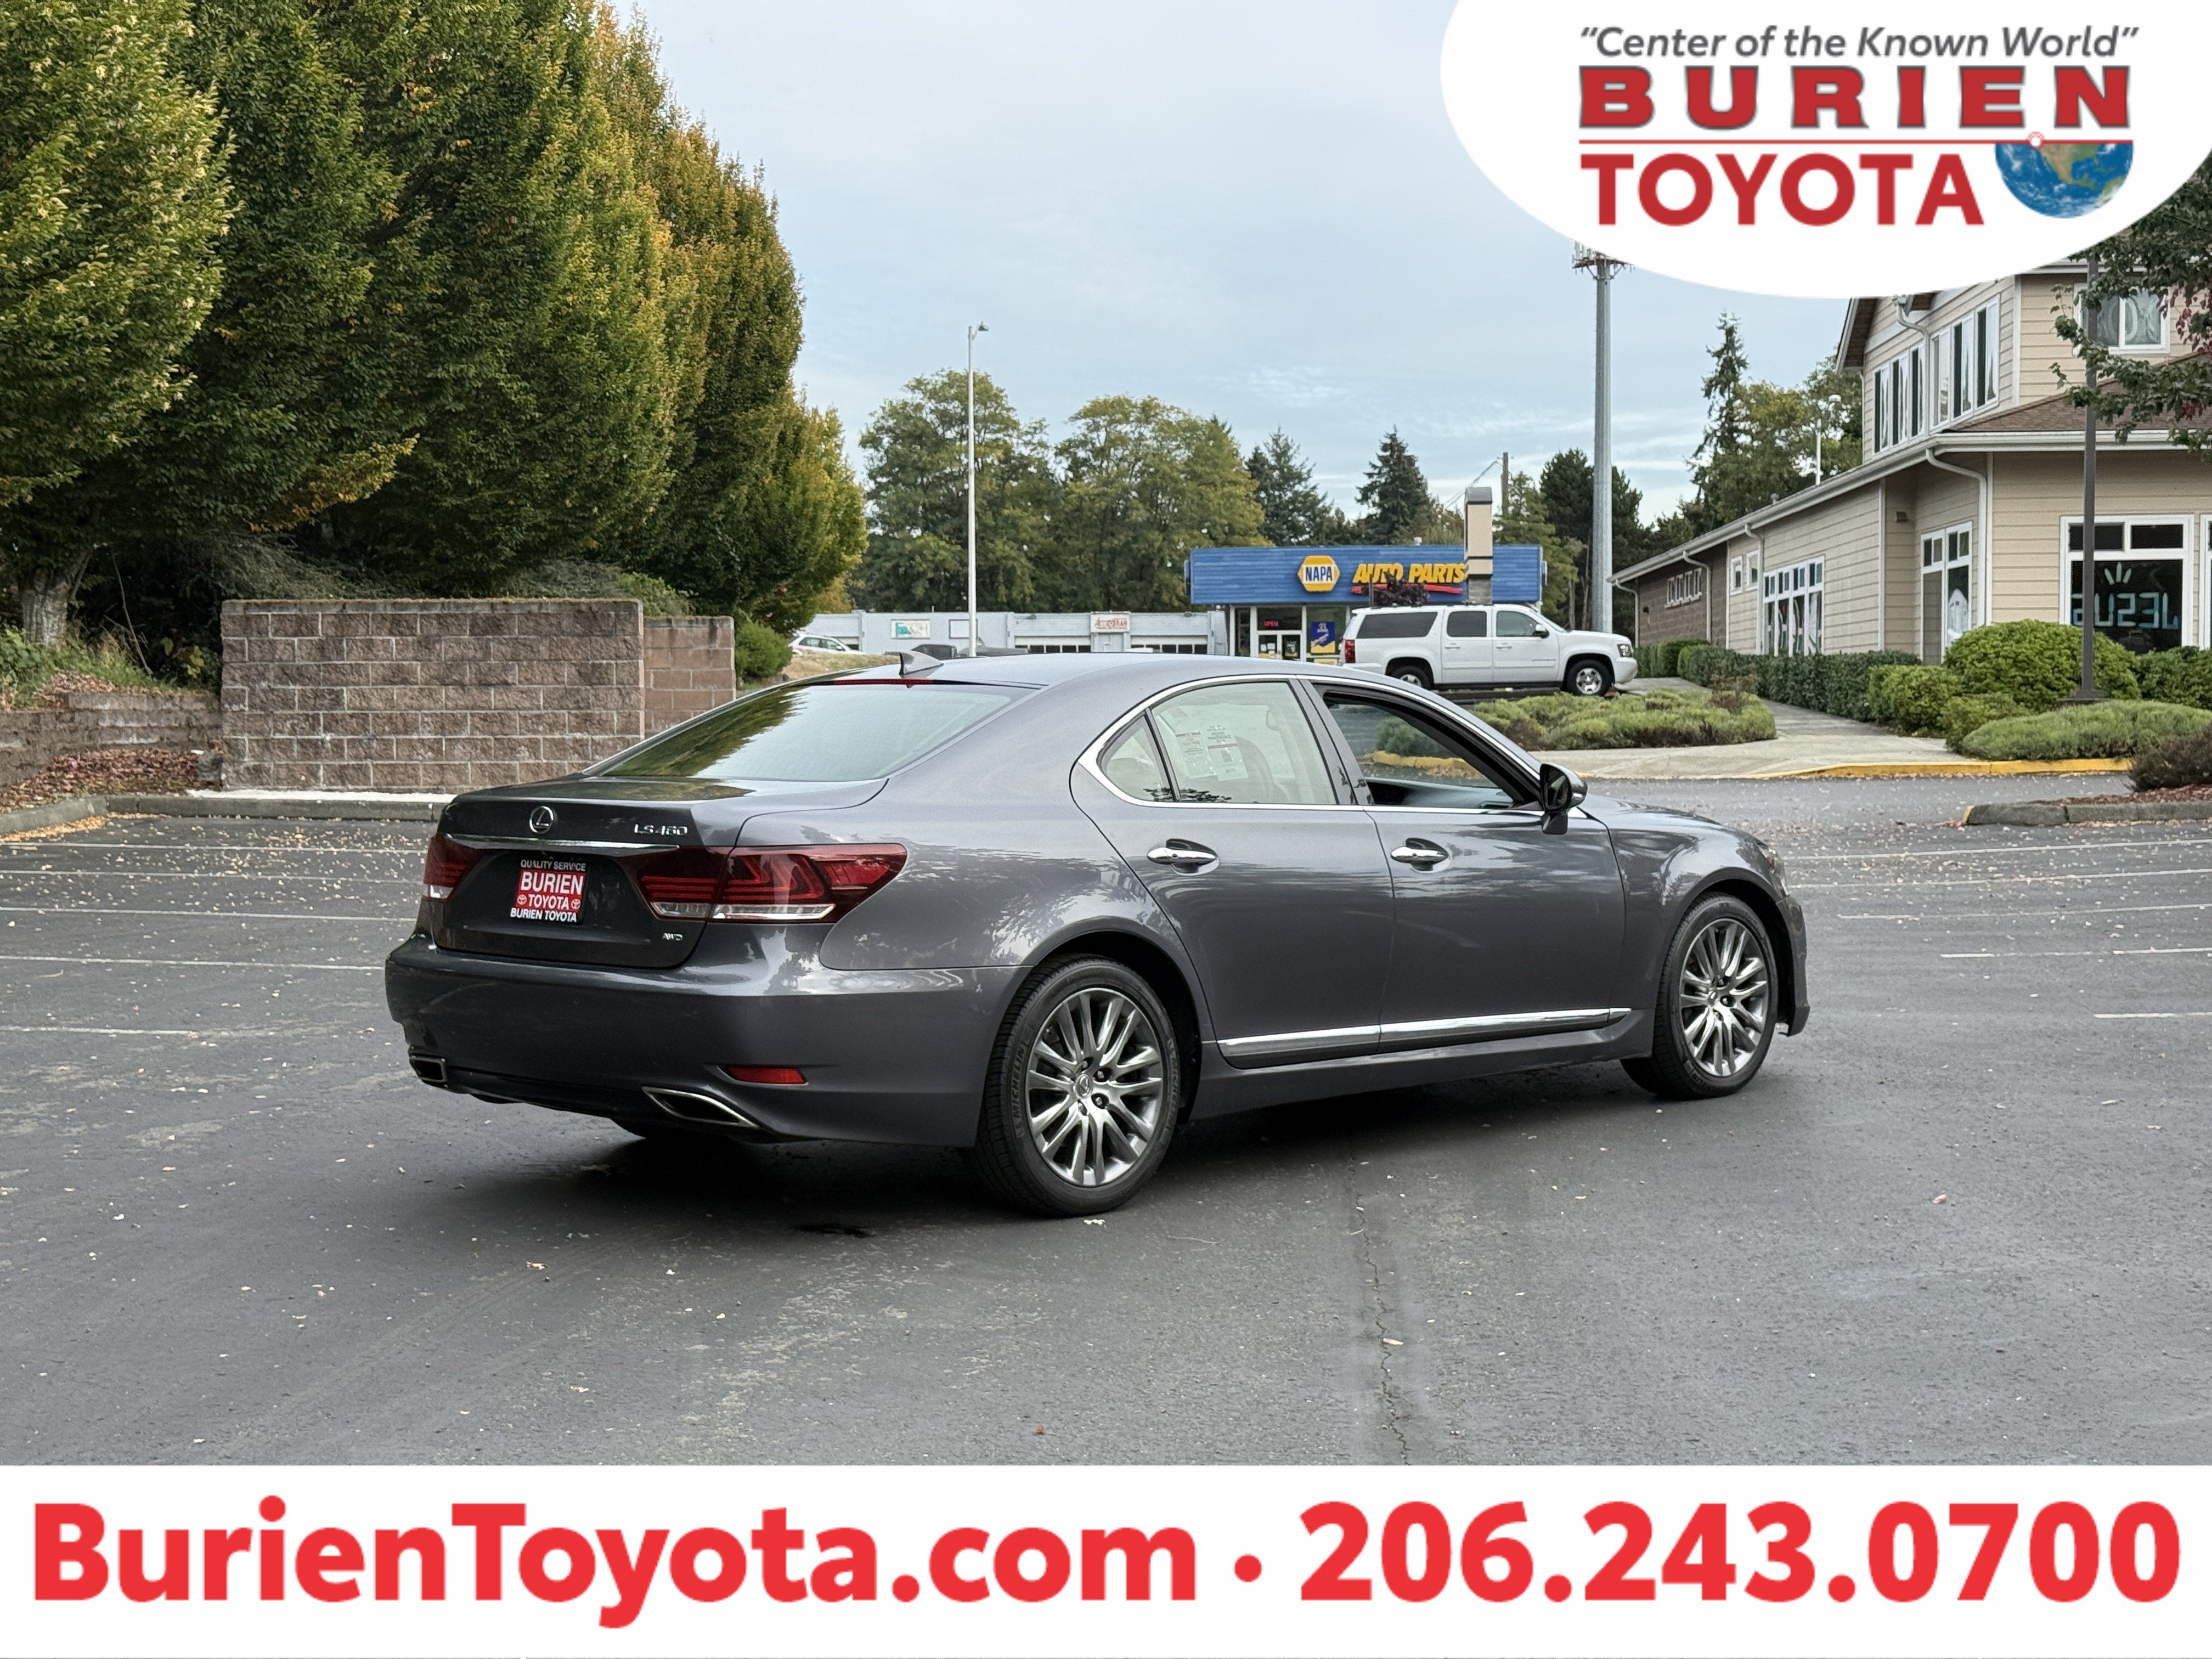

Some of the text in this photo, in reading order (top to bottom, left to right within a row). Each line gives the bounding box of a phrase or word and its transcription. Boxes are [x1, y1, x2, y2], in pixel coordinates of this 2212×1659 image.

[1305, 566, 1333, 582] NAPA
[1352, 563, 1465, 583] AUTO PARTS
[521, 859, 586, 872] QUALITY SERVICE
[521, 871, 584, 895] BURIEN
[528, 894, 569, 910] TOYOTA
[510, 907, 577, 922] BURIEN TOYOTA
[662, 933, 683, 941] AWD
[1011, 1042, 1025, 1119] MICHELIN
